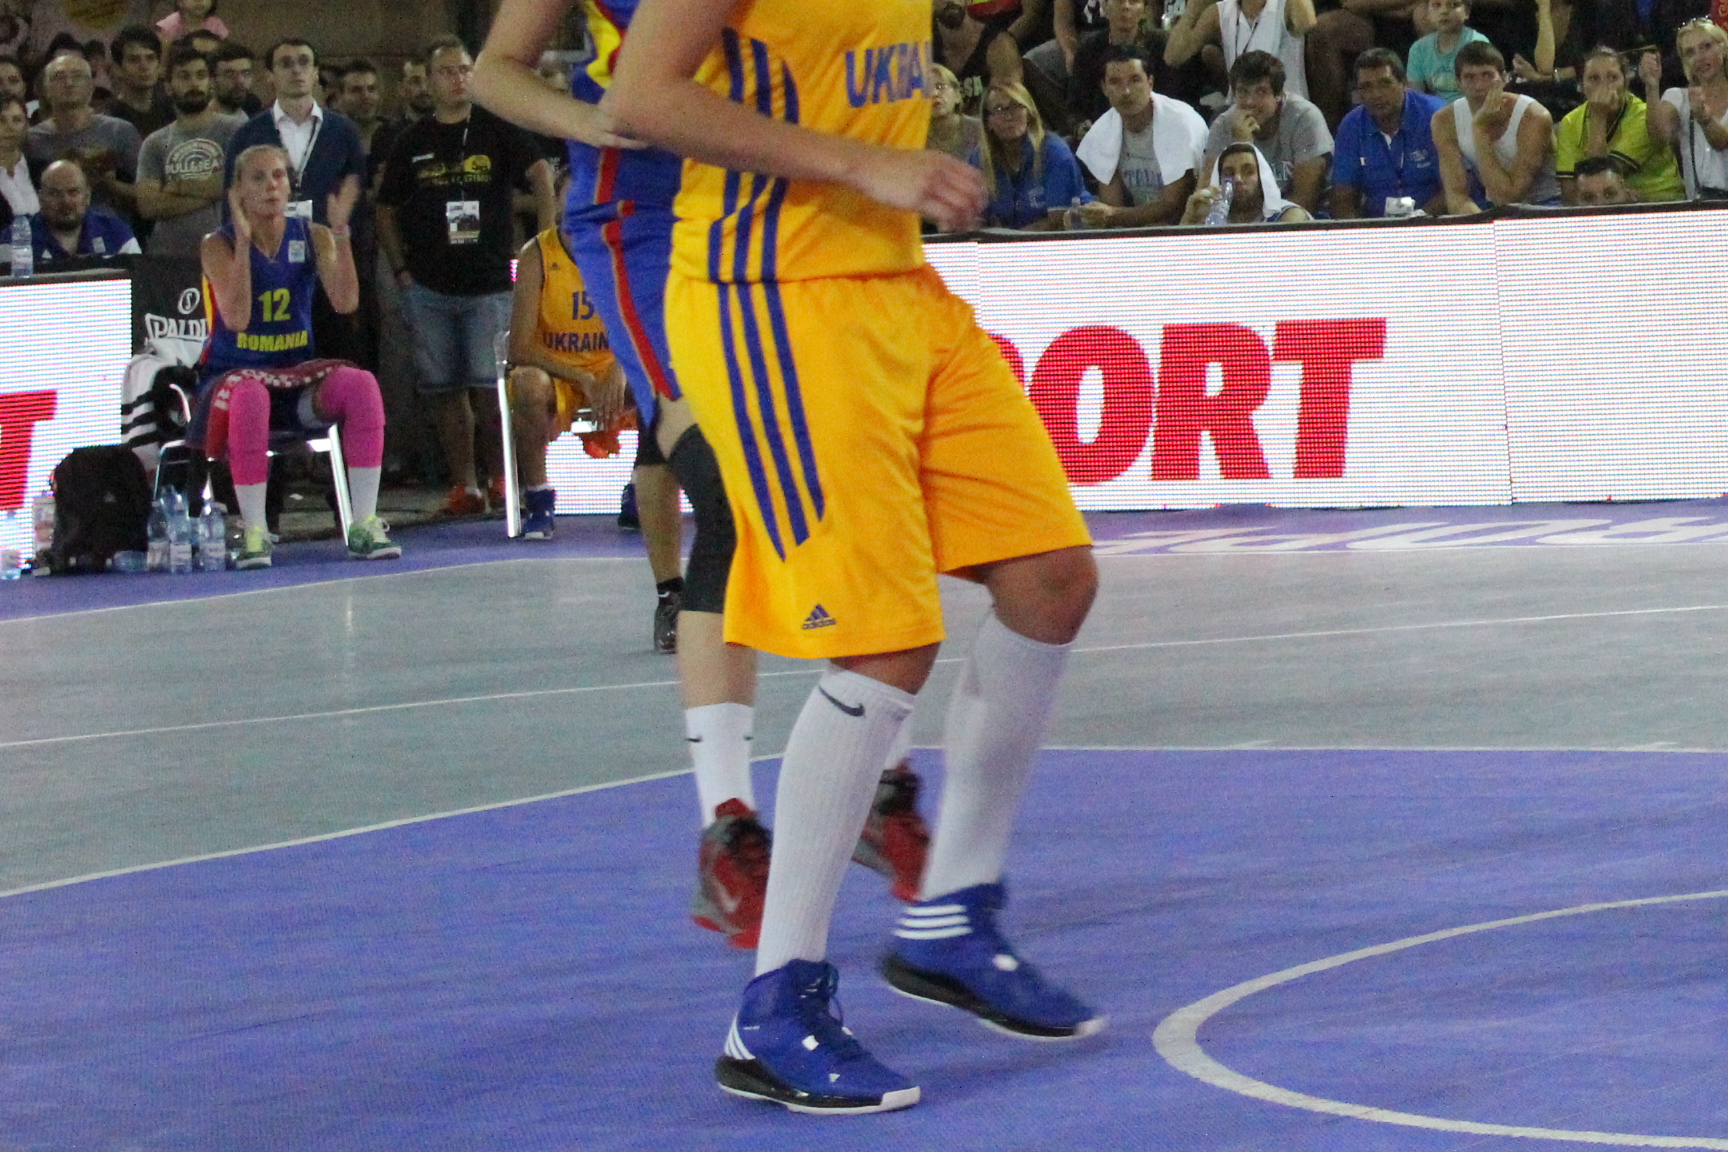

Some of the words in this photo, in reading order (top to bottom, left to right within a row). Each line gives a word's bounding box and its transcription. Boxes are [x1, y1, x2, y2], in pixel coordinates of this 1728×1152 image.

[258, 287, 292, 322] 12
[571, 291, 595, 321] 15
[237, 331, 309, 352] ROMANIA
[544, 332, 608, 352] UKRAIN
[1027, 318, 1387, 486] ORT
